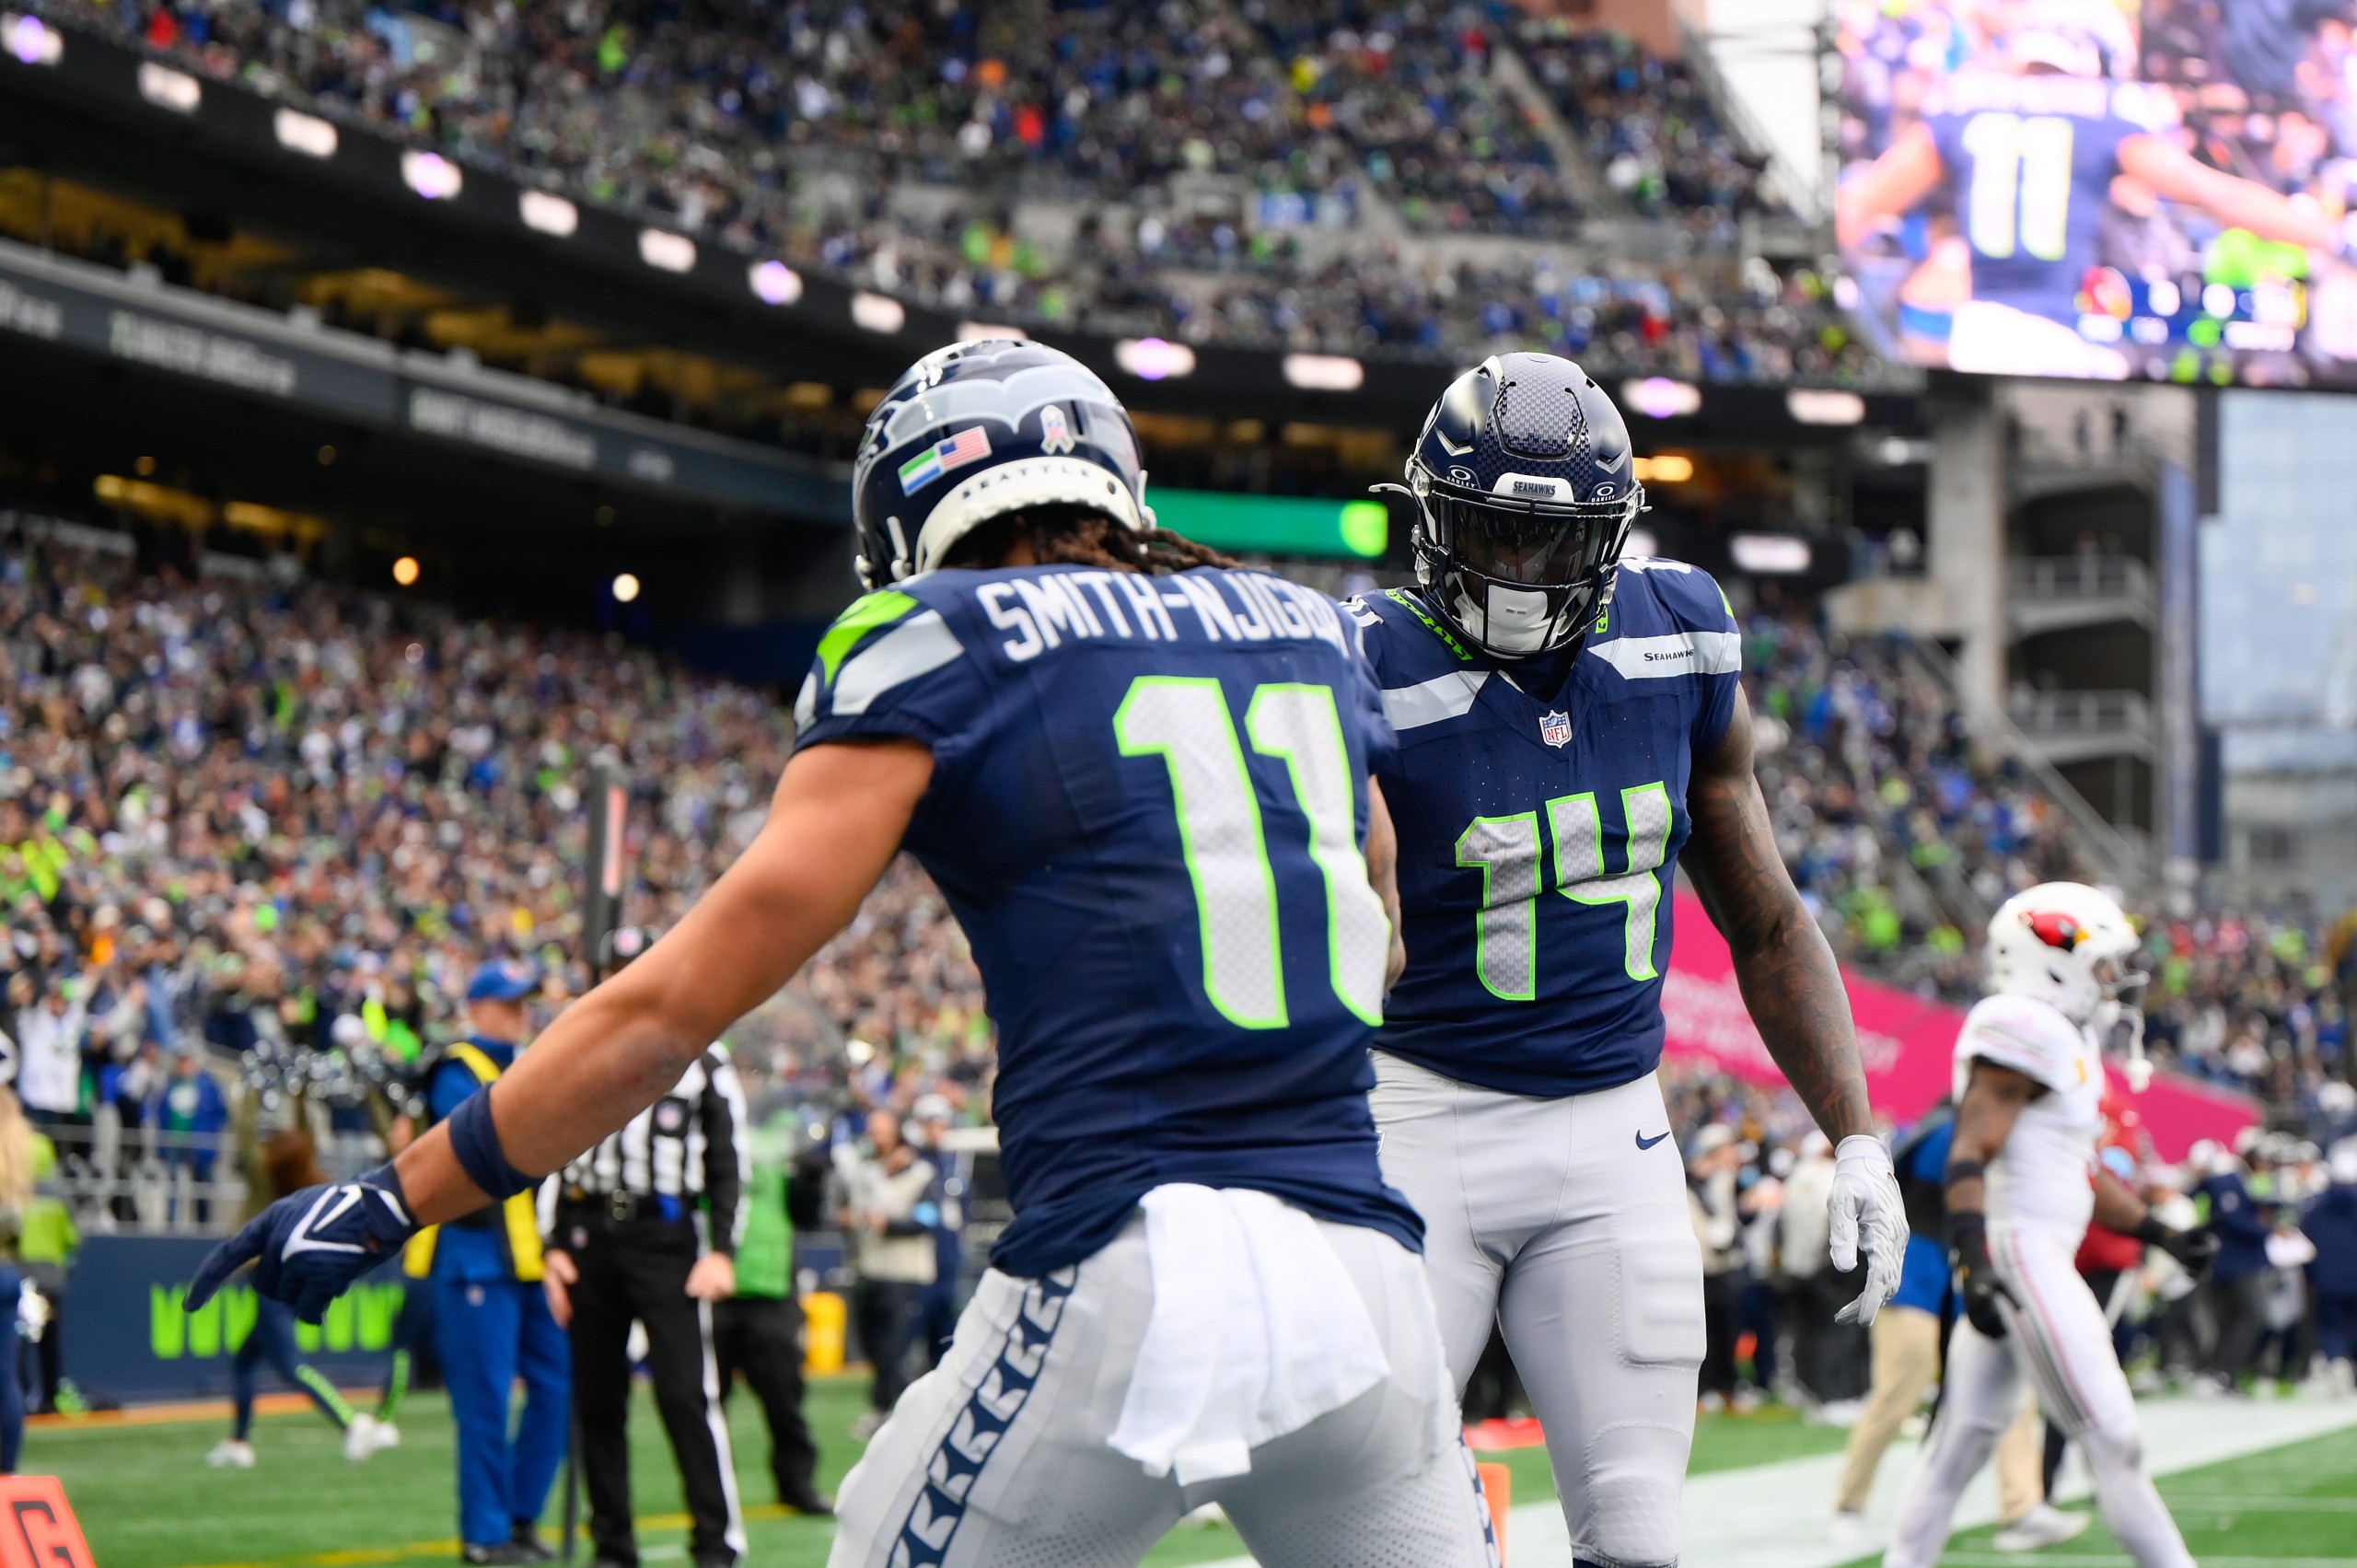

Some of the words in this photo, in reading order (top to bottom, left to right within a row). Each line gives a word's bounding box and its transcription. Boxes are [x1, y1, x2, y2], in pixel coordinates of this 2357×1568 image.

[1962, 111, 2074, 261] 11
[962, 466, 1090, 499] SEATTLE
[1513, 481, 1556, 496] SEAHAWKS
[1547, 726, 1568, 741] NFL
[1113, 675, 1392, 1030] 11
[1455, 780, 1673, 1002] 14
